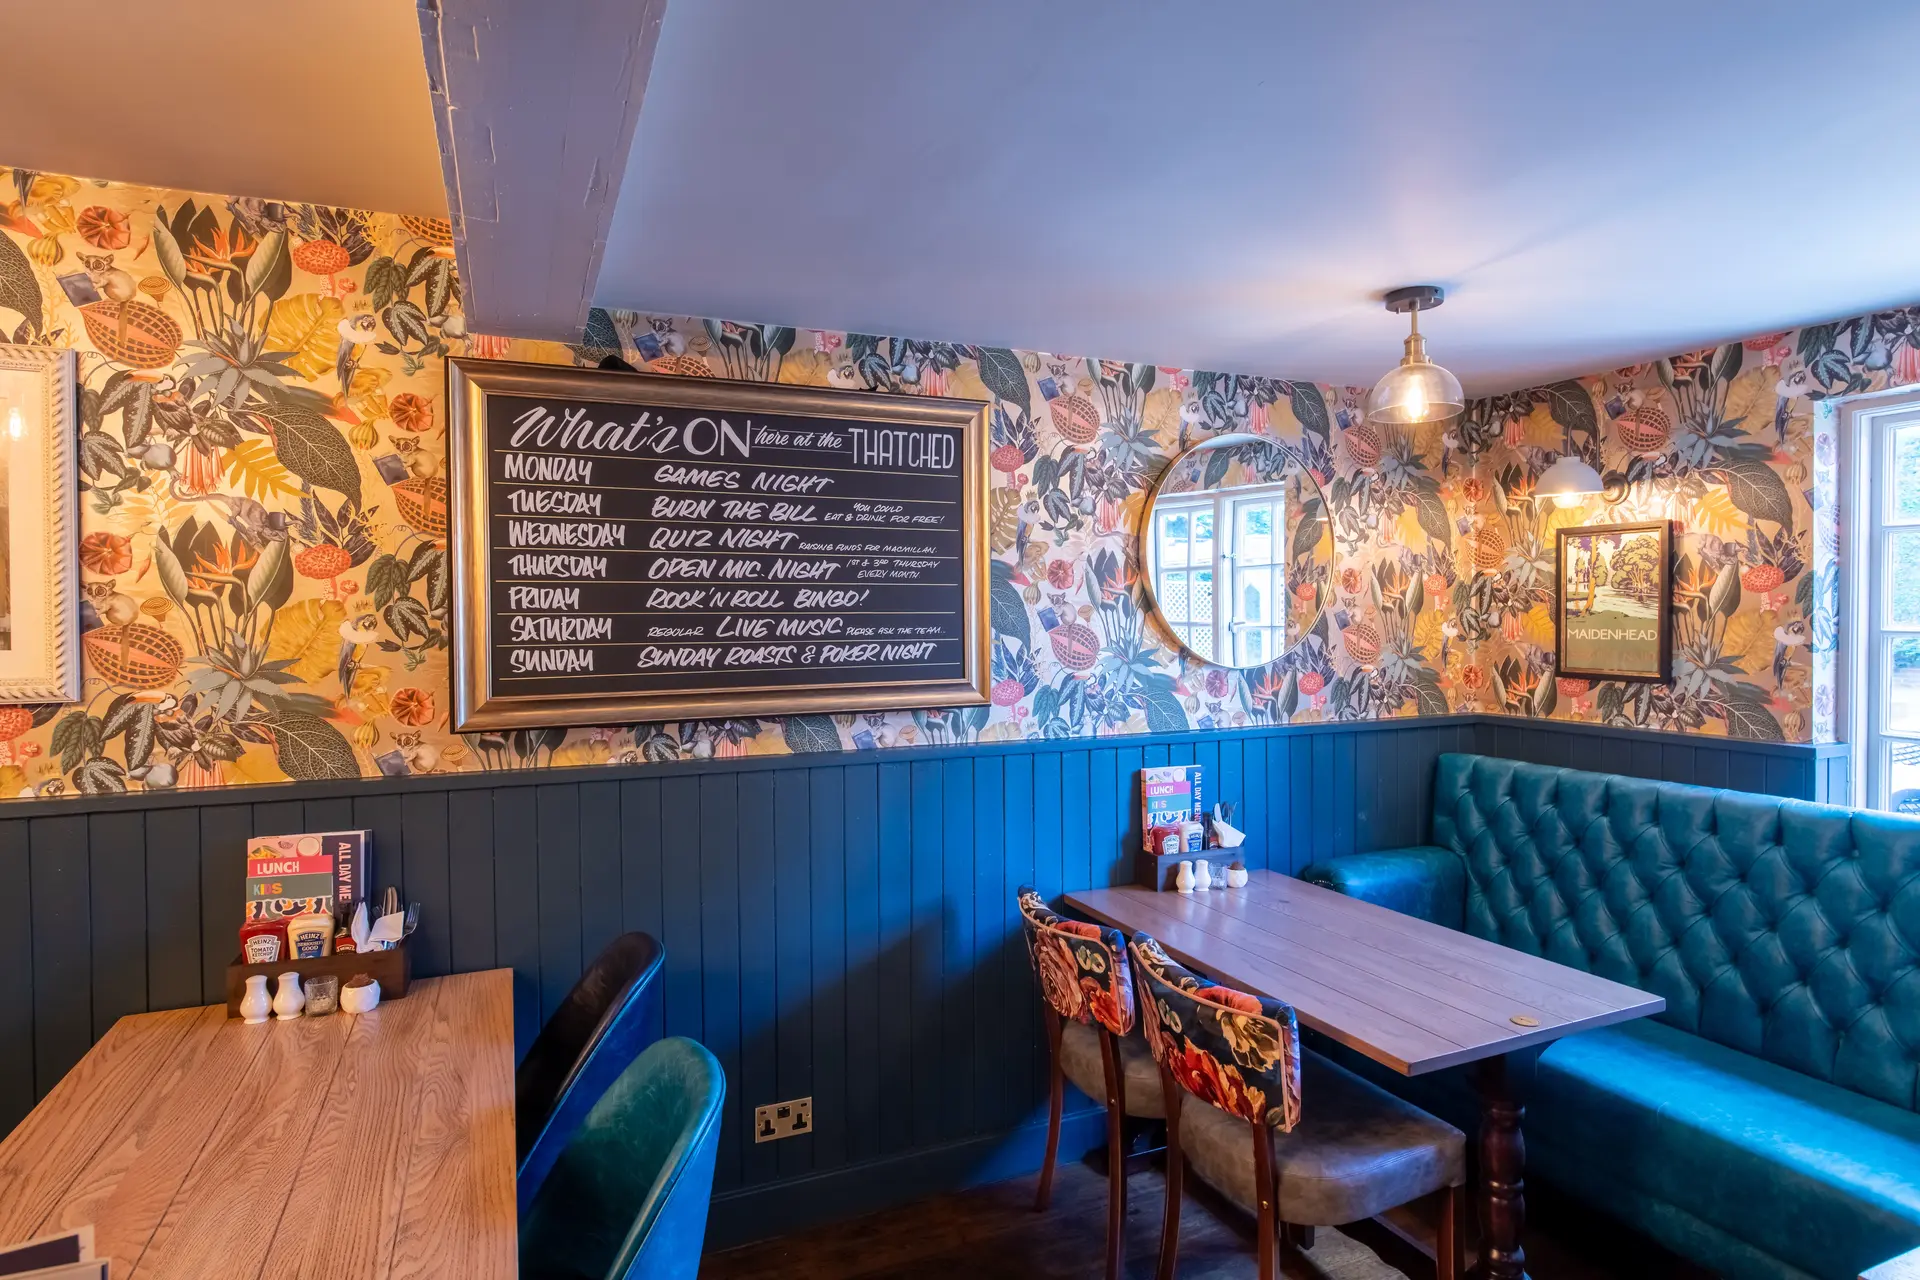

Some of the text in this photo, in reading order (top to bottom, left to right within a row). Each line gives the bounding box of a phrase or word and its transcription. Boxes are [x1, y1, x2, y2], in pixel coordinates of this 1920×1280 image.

[510, 406, 955, 469] What's ON here at the THATCHED
[504, 453, 593, 484] MONDAY
[654, 464, 835, 494] GAMES NIGHT
[507, 489, 602, 516] TUESDAY
[651, 495, 818, 522] BURN THE BILL
[853, 502, 903, 513] YOU COULD
[824, 513, 945, 524] EAT & DRINK FOR FREE!
[508, 520, 626, 548] WEDNESDAY
[649, 527, 799, 550] QUIZ NIGHT
[798, 542, 834, 551] RAISING
[835, 543, 862, 552] FUNDS
[864, 544, 881, 552] FOR
[507, 554, 608, 578] THURSDAY
[648, 557, 841, 580] OPEN MIC. NIGHT
[857, 570, 888, 579] EVERY
[861, 559, 870, 567] &
[873, 559, 889, 567] 3RD
[893, 560, 941, 569] THURSDAY
[508, 586, 580, 610] FRIDAY
[730, 590, 785, 608] ROLL
[793, 589, 870, 608] BINGO!
[510, 616, 612, 642] SATURDAY
[647, 626, 704, 637] REGULAR
[716, 616, 776, 638] LIVE
[775, 617, 843, 636] MUSIC
[846, 627, 876, 635] PLEASE
[897, 627, 912, 635] THE
[1567, 628, 1658, 641] MAIDENHEAD
[510, 649, 594, 673] SUNDAY
[637, 642, 938, 668] SUNDAY ROASTS & POKER NIGHT
[1194, 771, 1202, 786] ALL
[1150, 785, 1174, 795] LUNCH
[1194, 787, 1202, 801] DAY
[338, 842, 352, 862] ALL
[257, 861, 300, 875] LUNCH
[338, 863, 352, 883] DAY
[253, 882, 283, 896] KIDS
